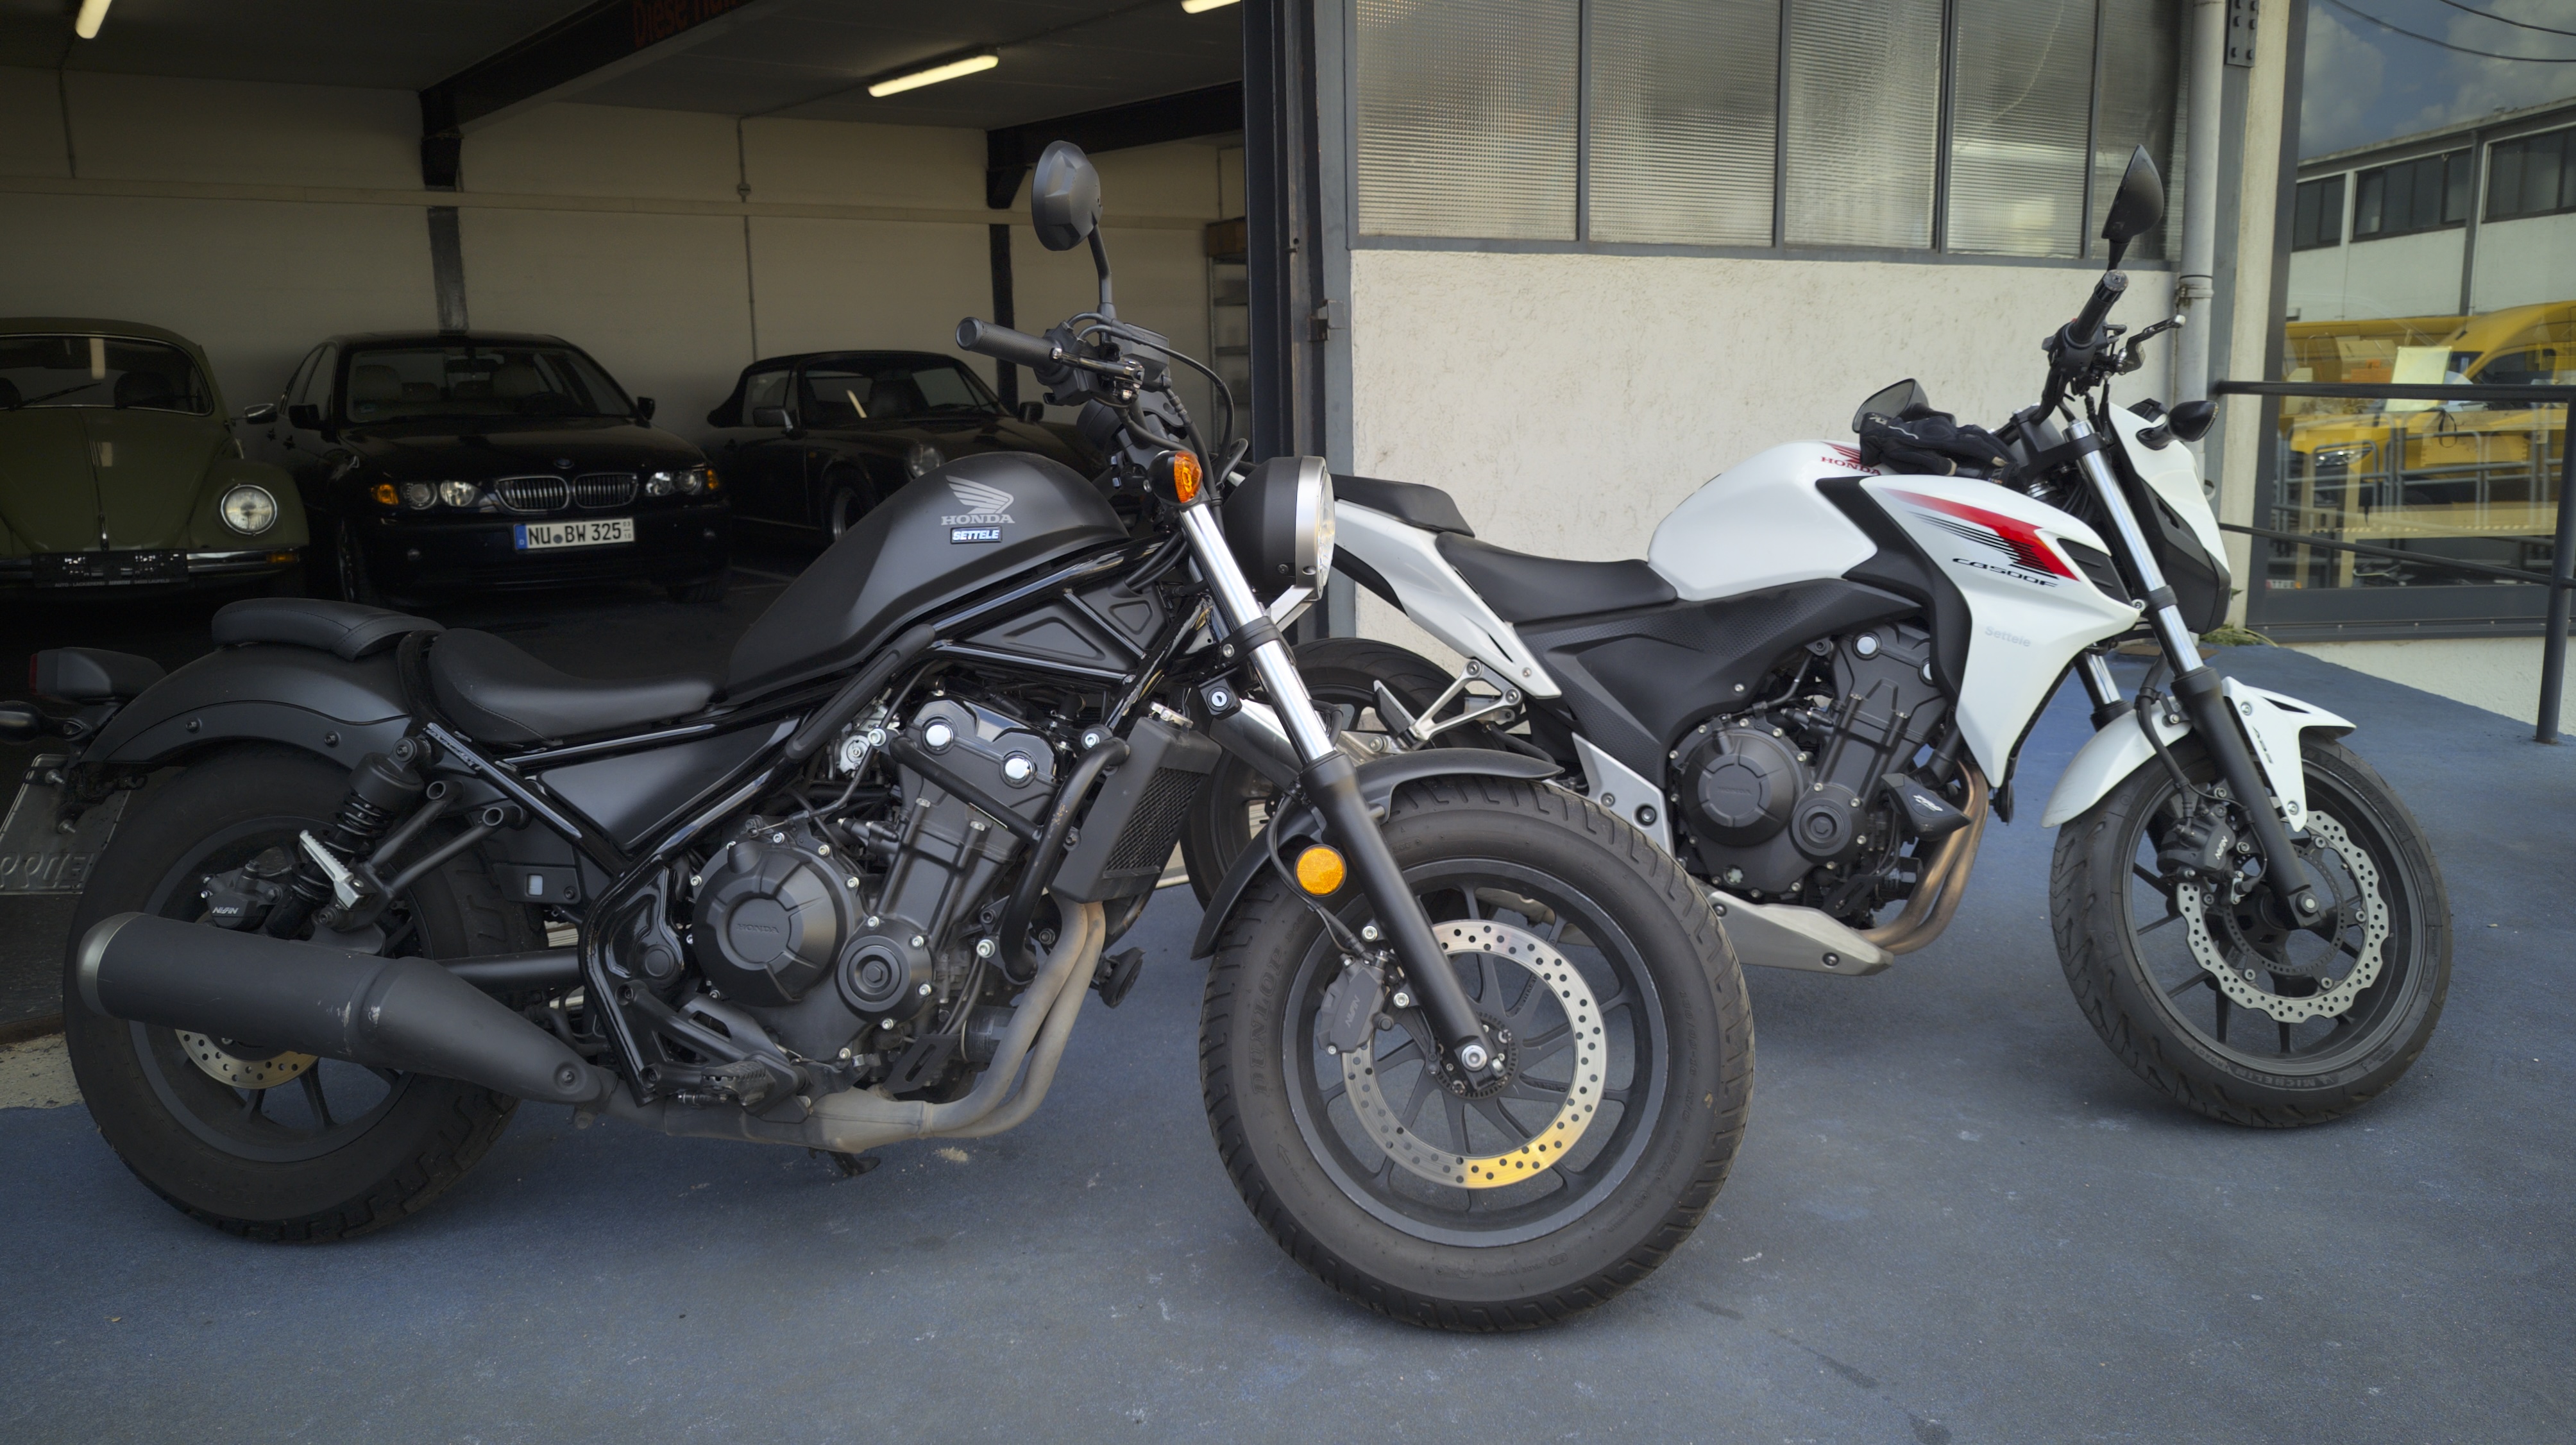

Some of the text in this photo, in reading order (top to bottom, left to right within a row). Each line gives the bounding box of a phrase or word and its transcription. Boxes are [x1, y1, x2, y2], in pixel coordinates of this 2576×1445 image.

[1819, 455, 1883, 475] HONDA
[940, 514, 1016, 526] HONDA
[528, 522, 622, 545] NU BW 325
[953, 529, 1000, 541] SETTELE
[1985, 625, 2032, 647] Settele
[736, 923, 780, 934] HONDA
[1250, 946, 1284, 1097] DUNLOP
[2235, 1068, 2317, 1088] MICHELIN
